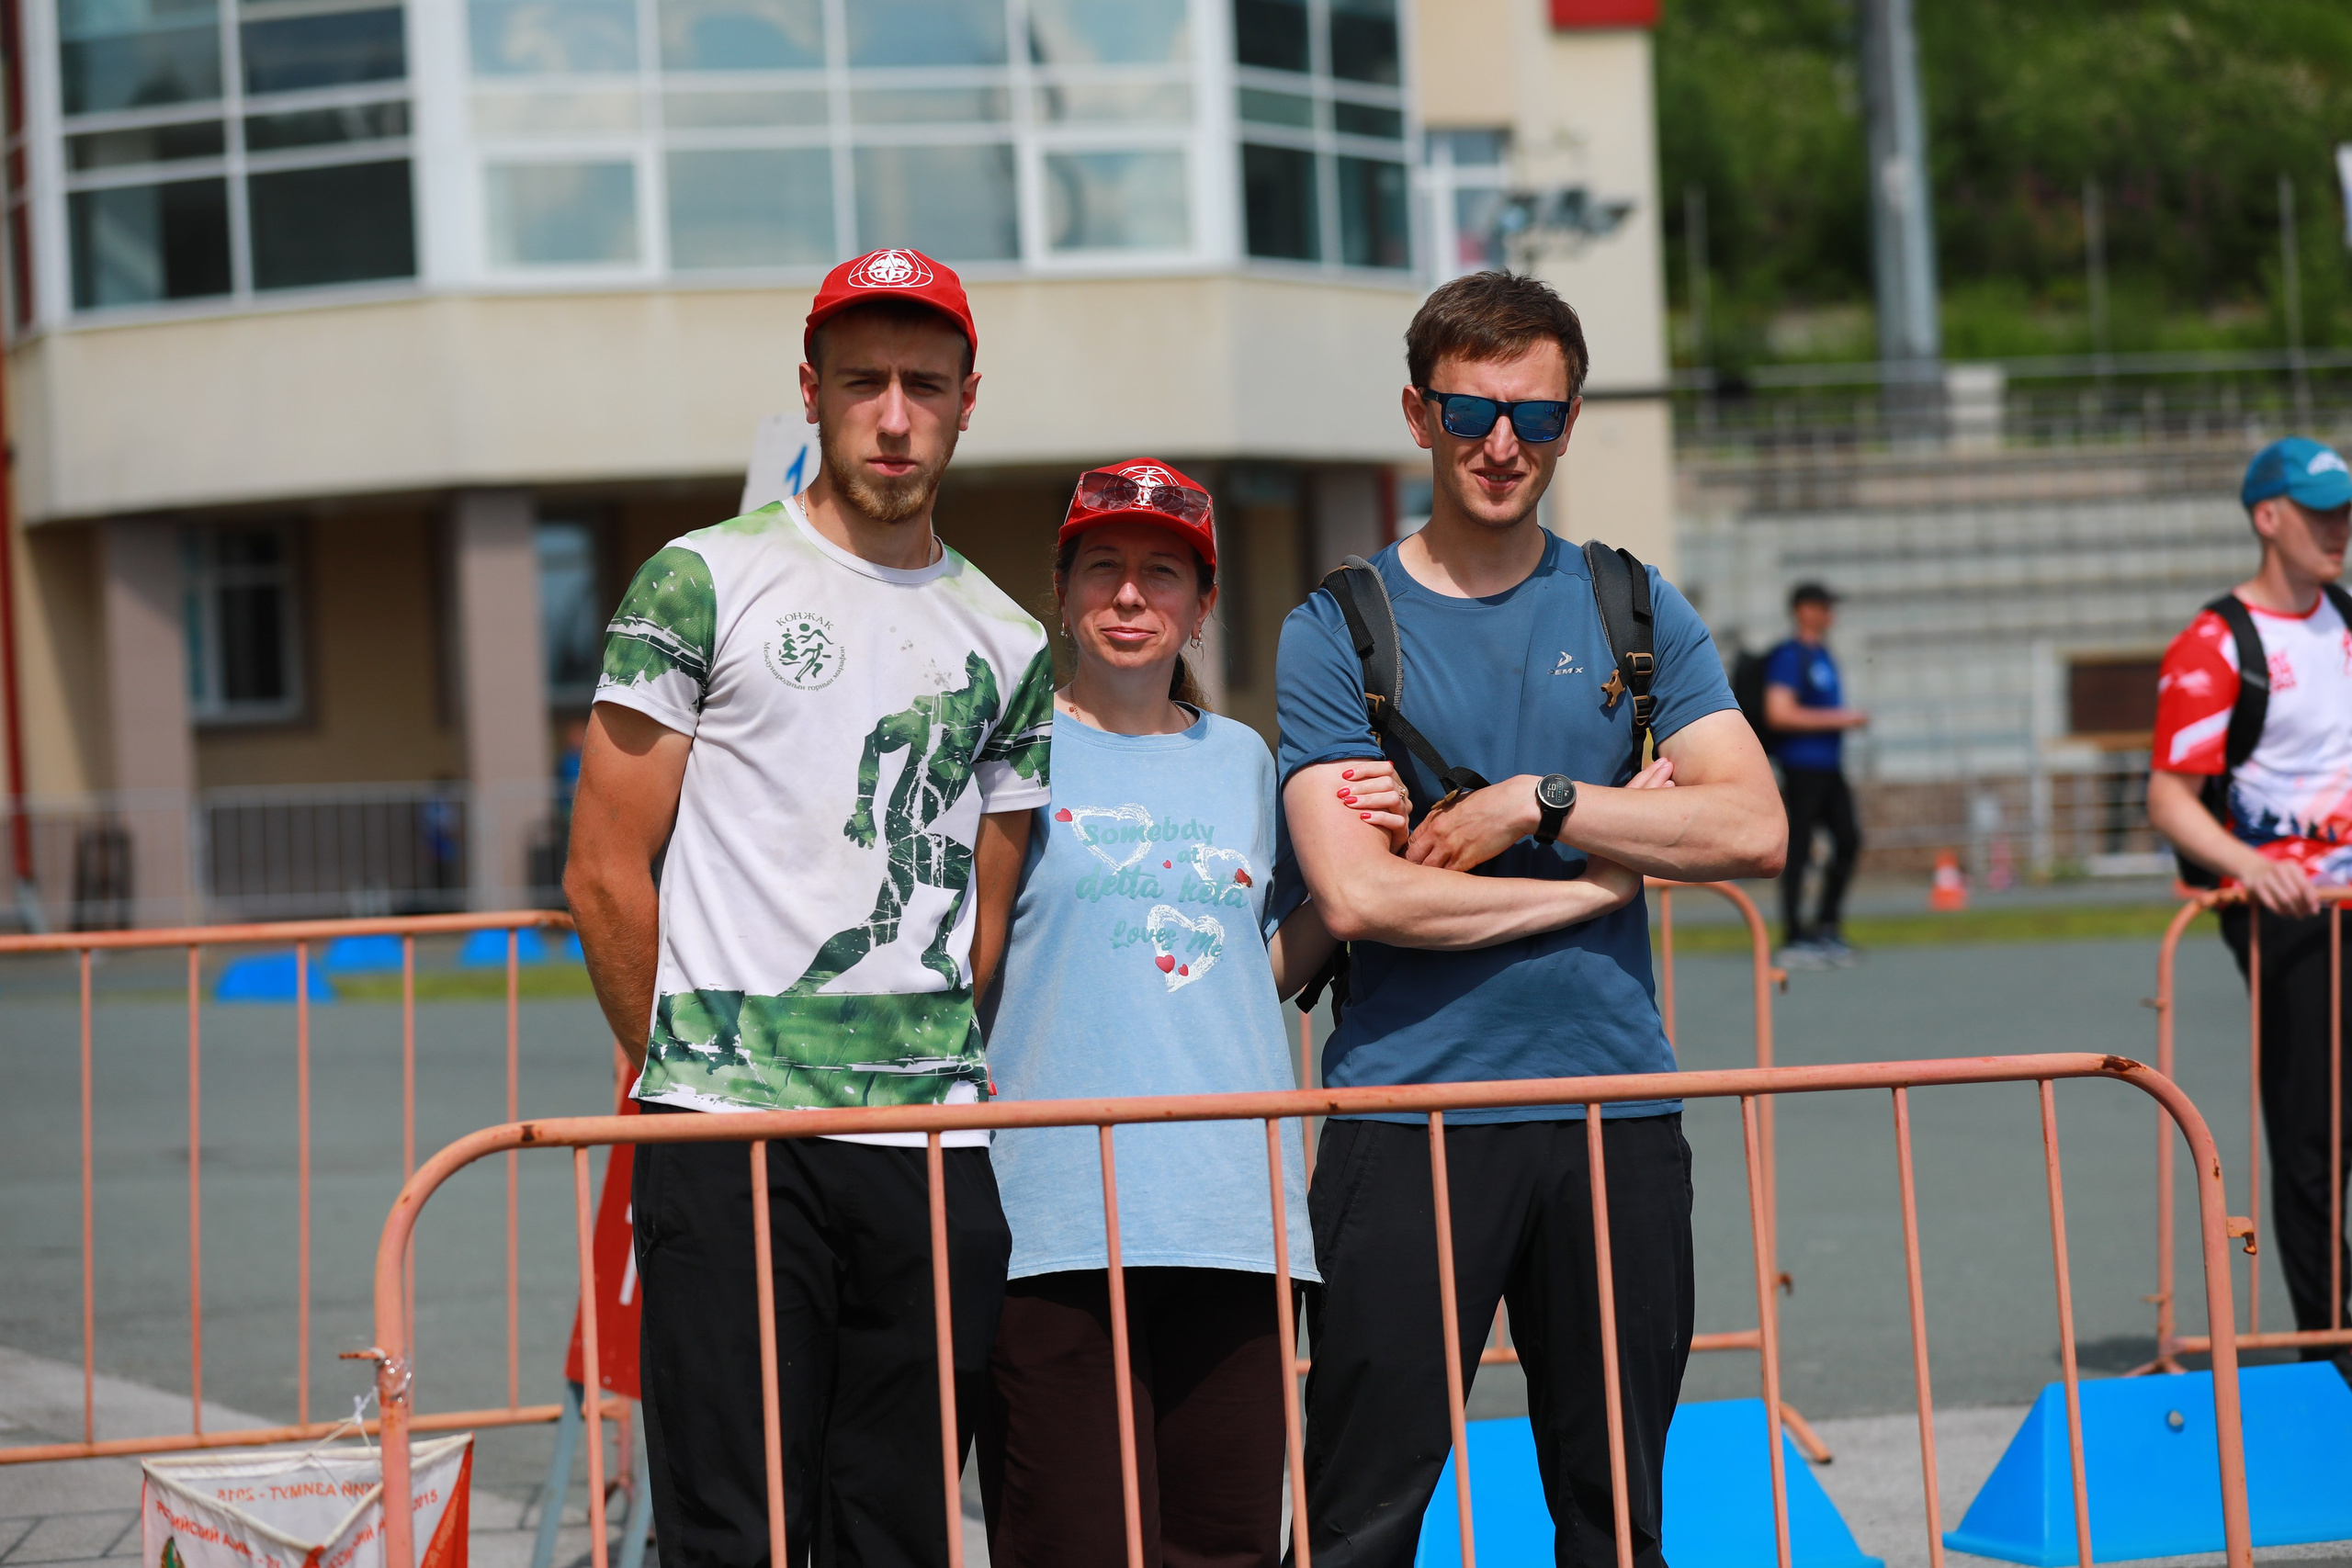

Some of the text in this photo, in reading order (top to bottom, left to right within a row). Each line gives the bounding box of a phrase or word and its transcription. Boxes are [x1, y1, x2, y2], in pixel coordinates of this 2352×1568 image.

[775, 612, 834, 631] КОНЖАК
[832, 646, 847, 680] марафон
[1177, 846, 1201, 863] at
